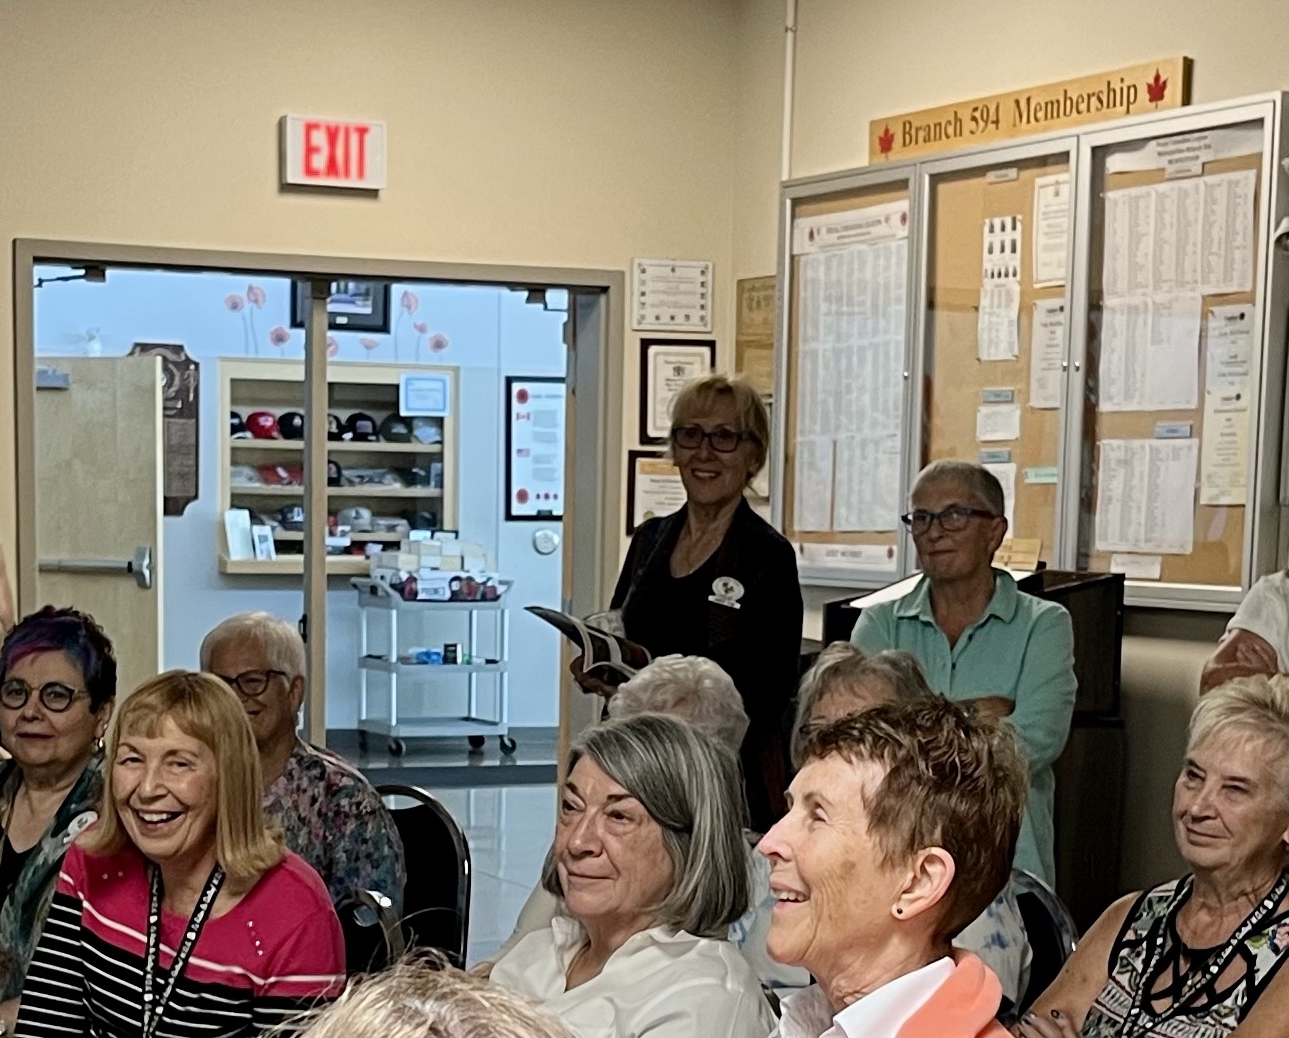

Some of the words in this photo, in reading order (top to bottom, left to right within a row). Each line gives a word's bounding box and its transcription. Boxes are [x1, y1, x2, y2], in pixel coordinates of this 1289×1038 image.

[901, 110, 963, 148] Branch
[969, 102, 1001, 135] 594
[1012, 77, 1138, 129] Membership
[303, 121, 370, 180] EXIT
